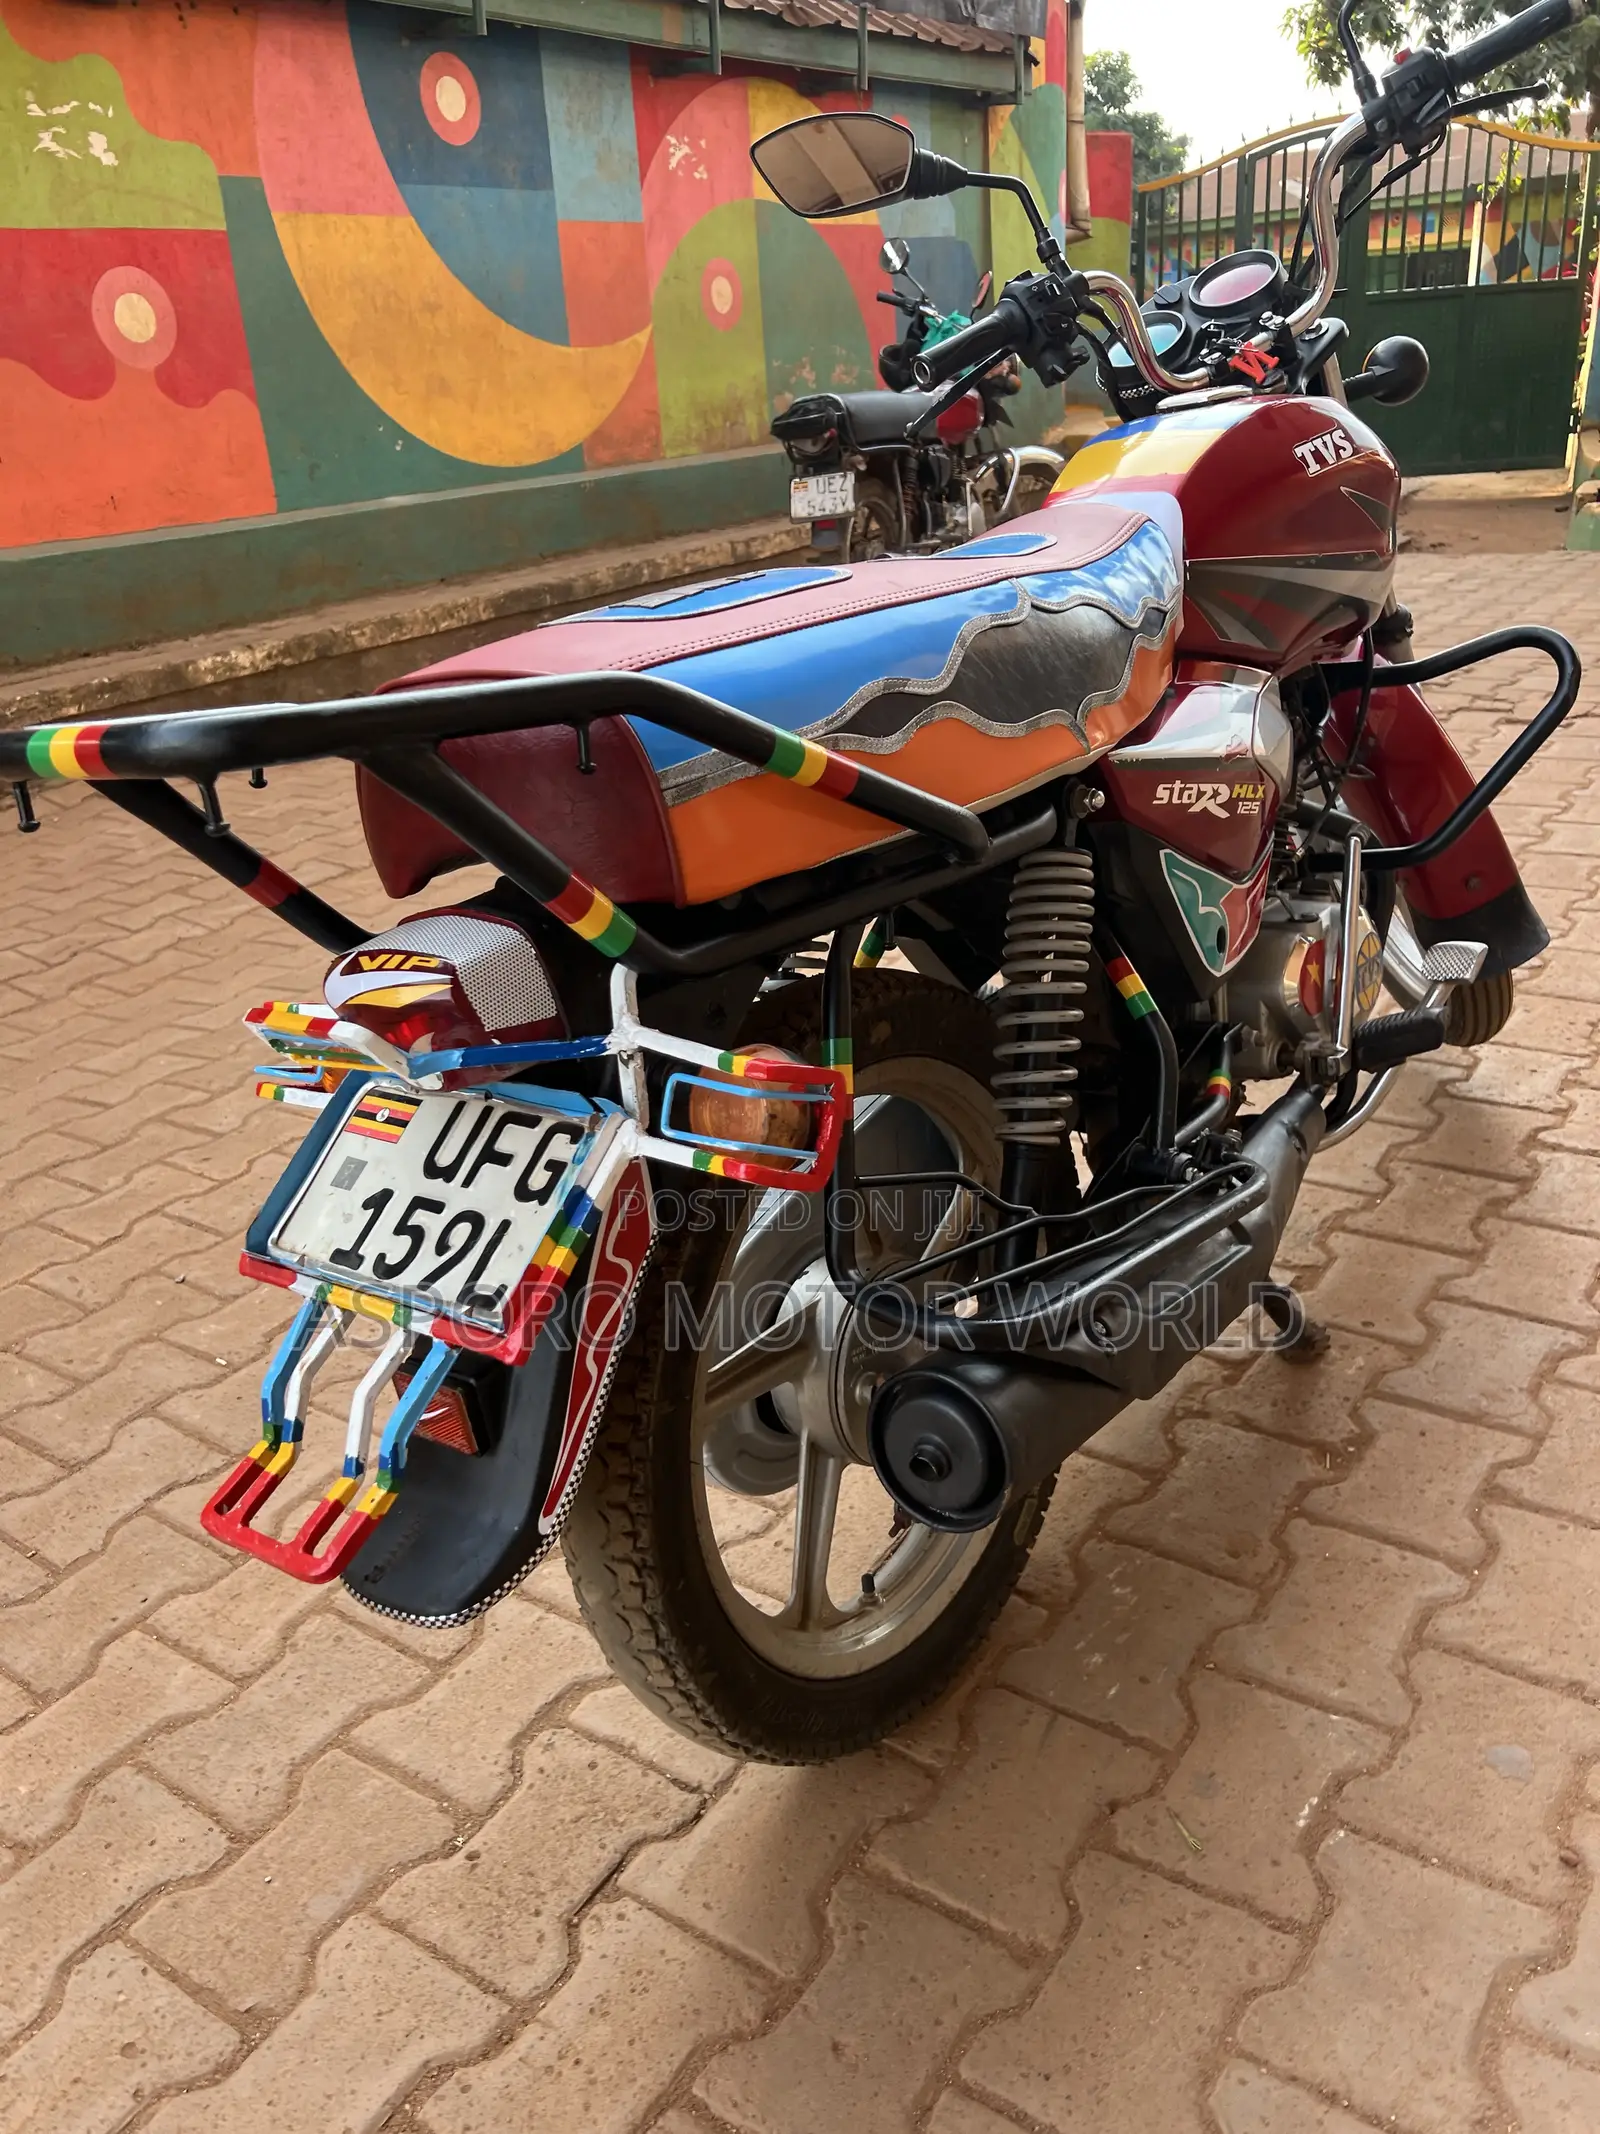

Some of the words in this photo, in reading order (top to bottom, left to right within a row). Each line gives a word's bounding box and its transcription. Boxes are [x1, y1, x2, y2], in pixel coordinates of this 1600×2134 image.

[1294, 429, 1353, 474] TVS
[816, 474, 848, 494] UEZ
[1231, 784, 1265, 799] HLX
[1237, 801, 1261, 815] 125
[358, 953, 440, 971] VIP
[423, 1100, 585, 1206] UFG
